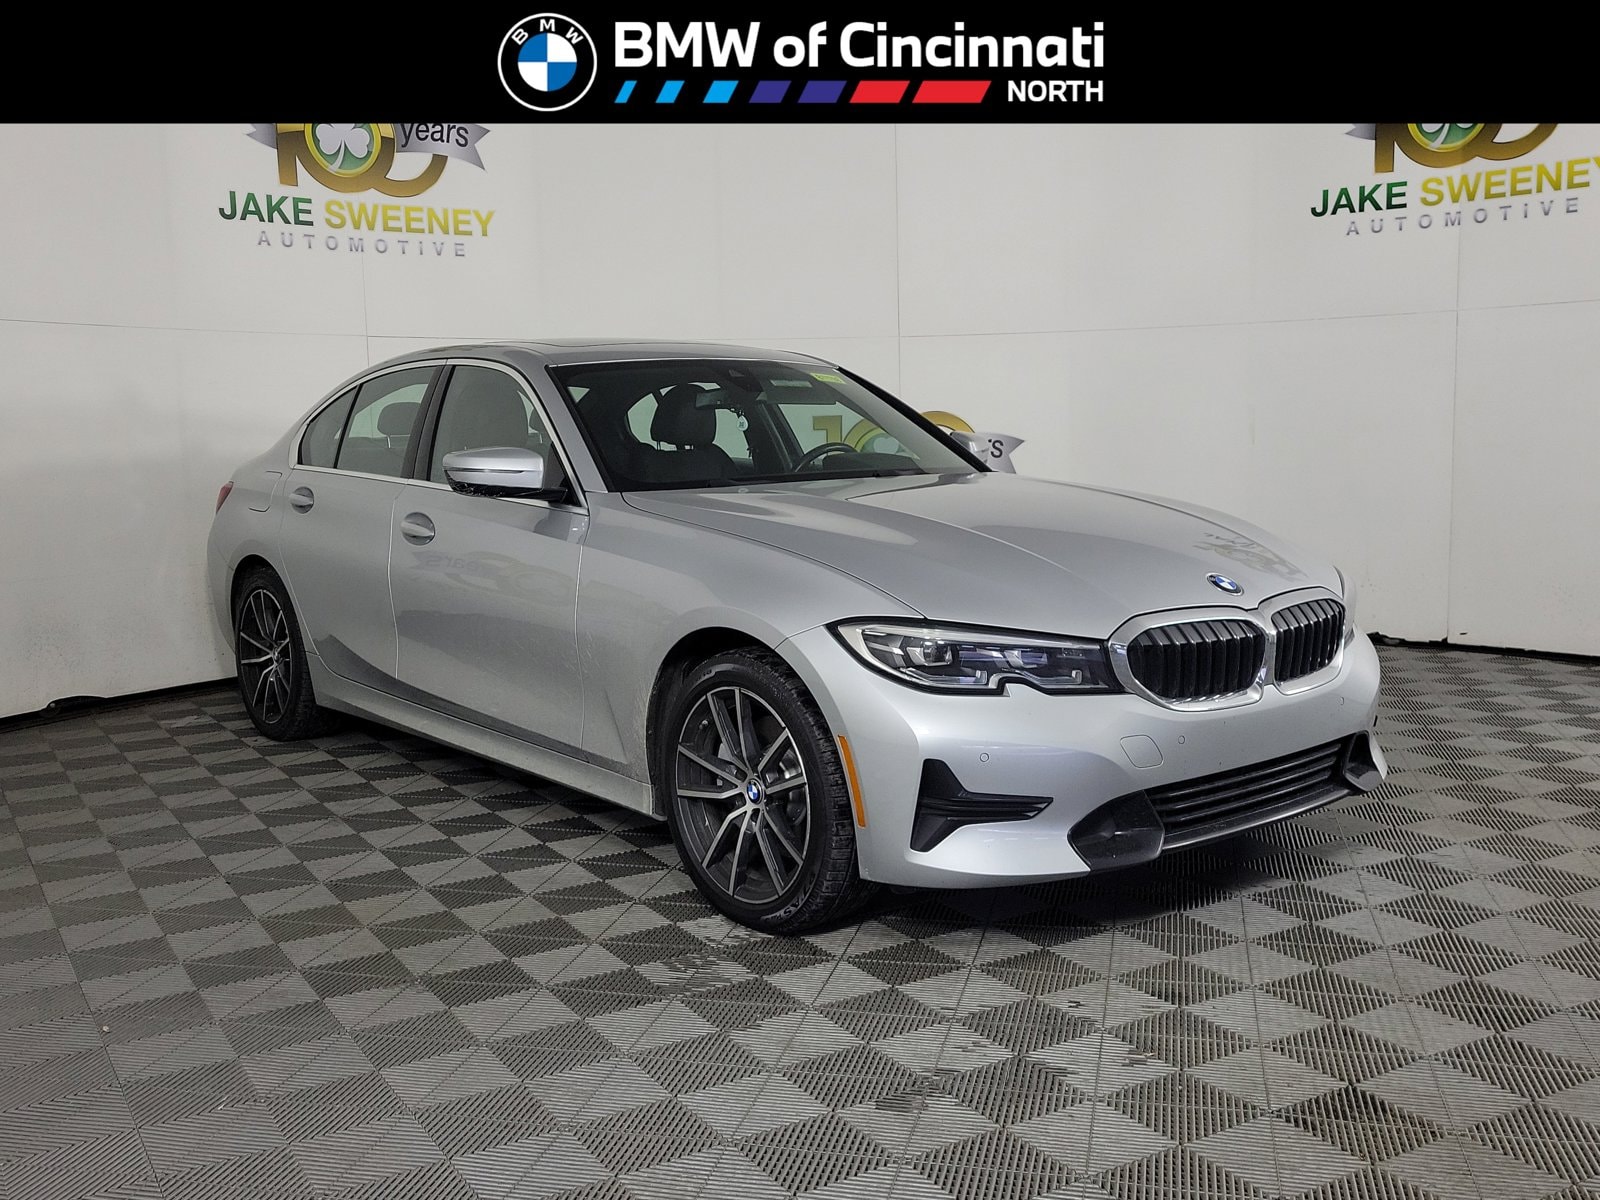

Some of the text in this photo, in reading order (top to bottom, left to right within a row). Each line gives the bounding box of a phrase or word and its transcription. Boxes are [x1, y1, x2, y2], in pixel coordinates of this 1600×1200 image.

[401, 123, 469, 147] years
[218, 190, 496, 237] JAKE SWEENEY
[1310, 181, 1408, 217] JAKE
[1346, 197, 1579, 236] AUTOMOTIVE
[257, 231, 465, 257] AUTOMOTIVE
